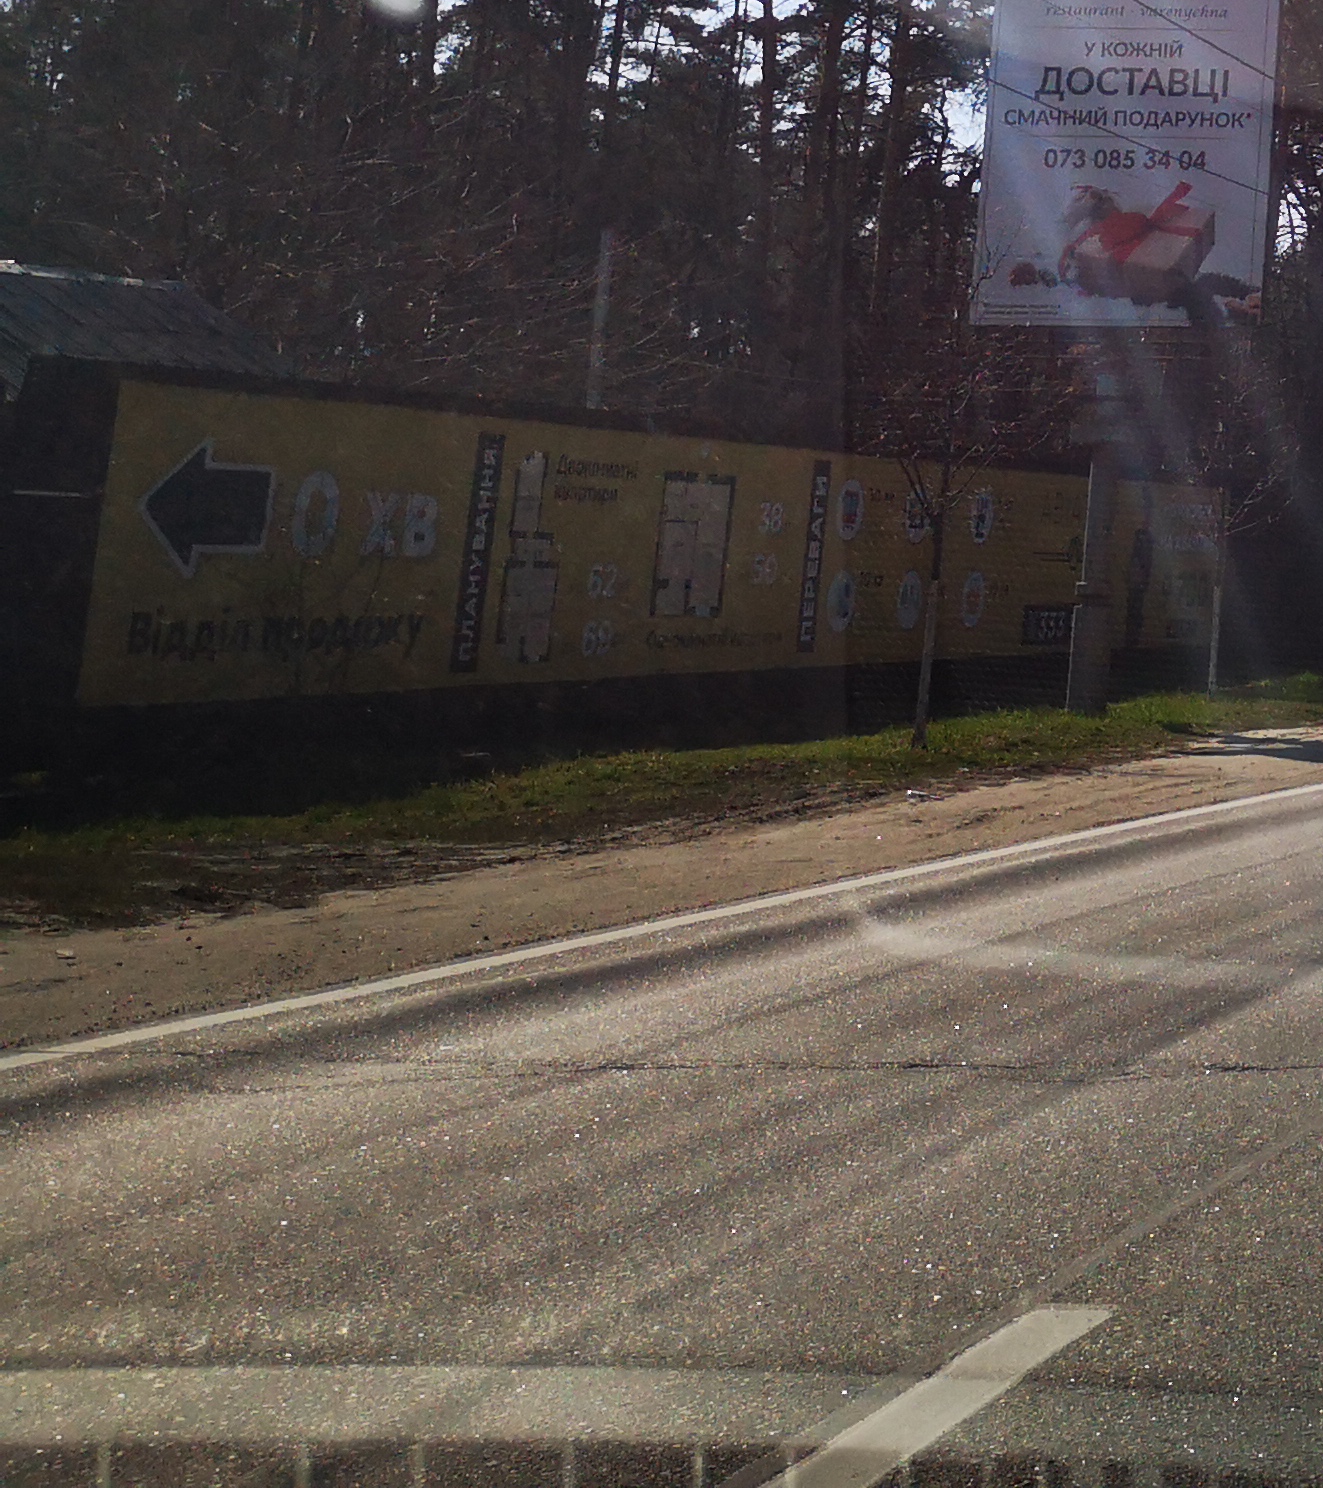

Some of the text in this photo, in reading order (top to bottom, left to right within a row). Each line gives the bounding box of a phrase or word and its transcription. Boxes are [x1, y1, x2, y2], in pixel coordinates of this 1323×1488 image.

[1083, 38, 1184, 59] У КОЖНІЙ
[1034, 65, 1230, 104] ДОСТАВЦІ
[1003, 107, 1108, 128] СМАЧНИЙ
[1043, 148, 1207, 171] 073 085 34 04
[800, 475, 829, 643] ПЕРЕВАГИ
